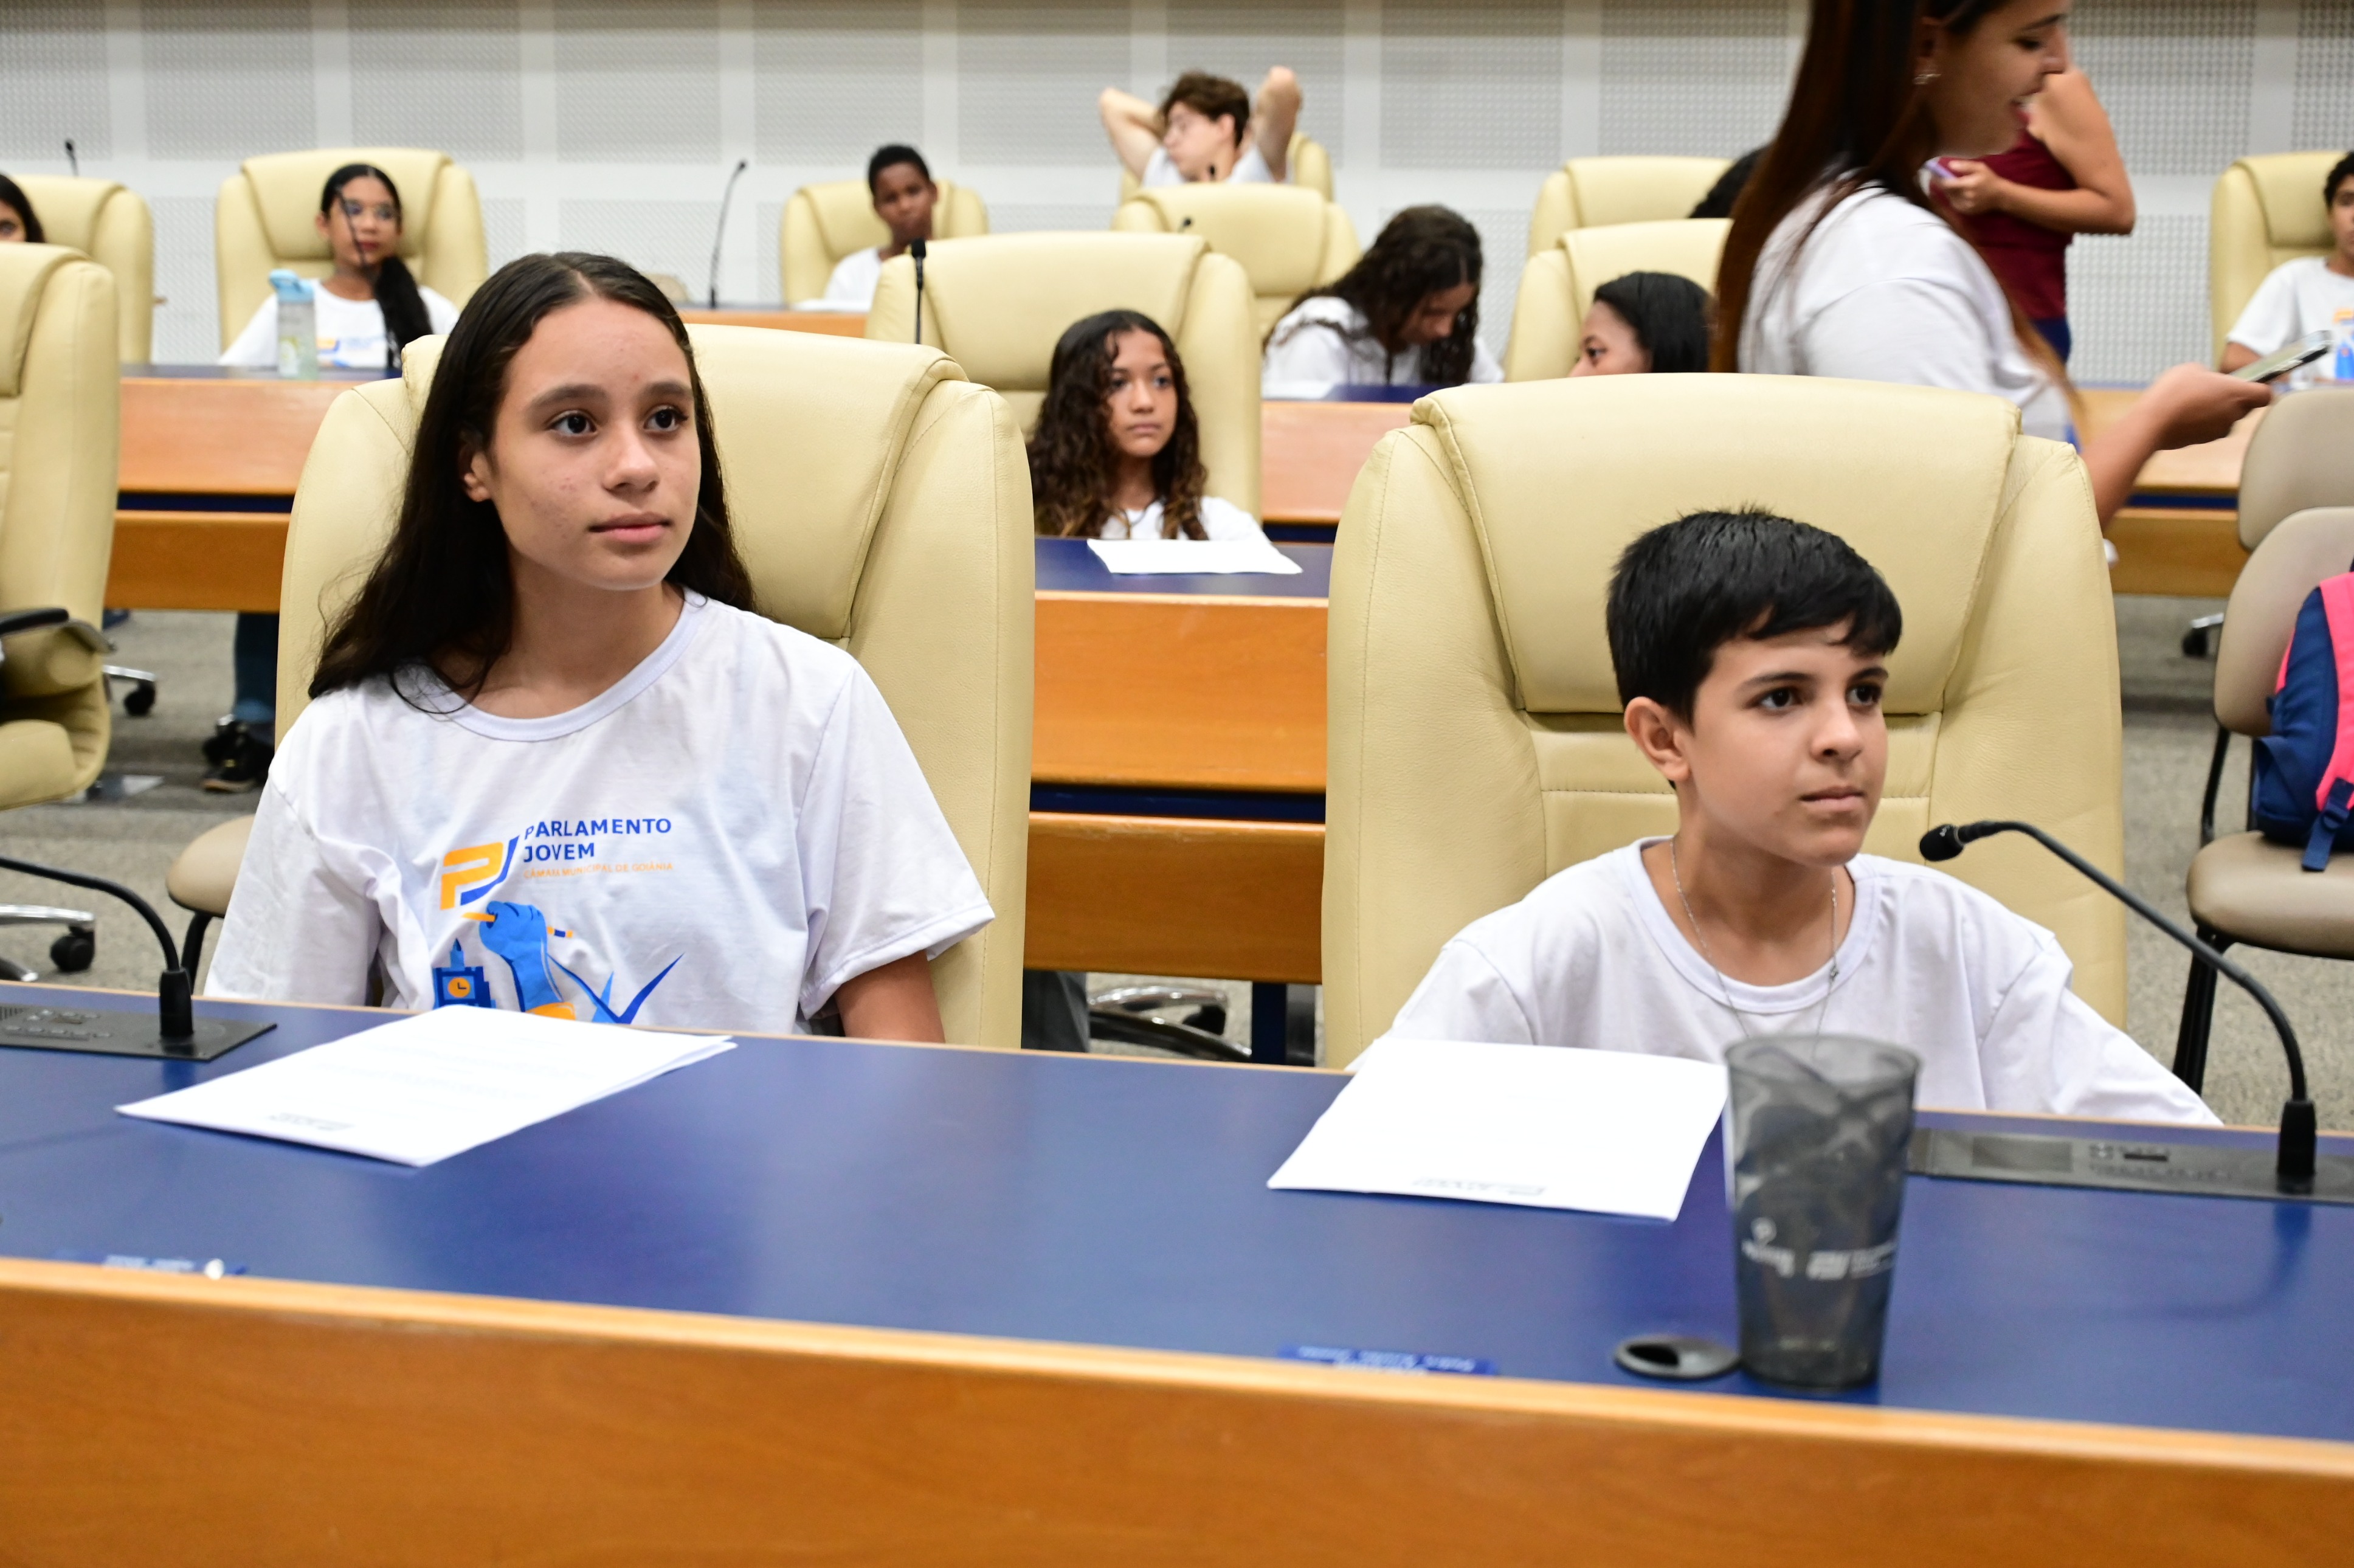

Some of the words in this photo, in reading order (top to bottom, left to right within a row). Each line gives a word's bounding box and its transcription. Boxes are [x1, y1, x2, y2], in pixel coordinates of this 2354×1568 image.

[525, 818, 672, 840] PARLAMENTO
[523, 843, 595, 863] JOVEM
[562, 863, 613, 876] MUNICIPAL
[615, 863, 629, 872] DE
[632, 860, 674, 871] GOIÂNIA
